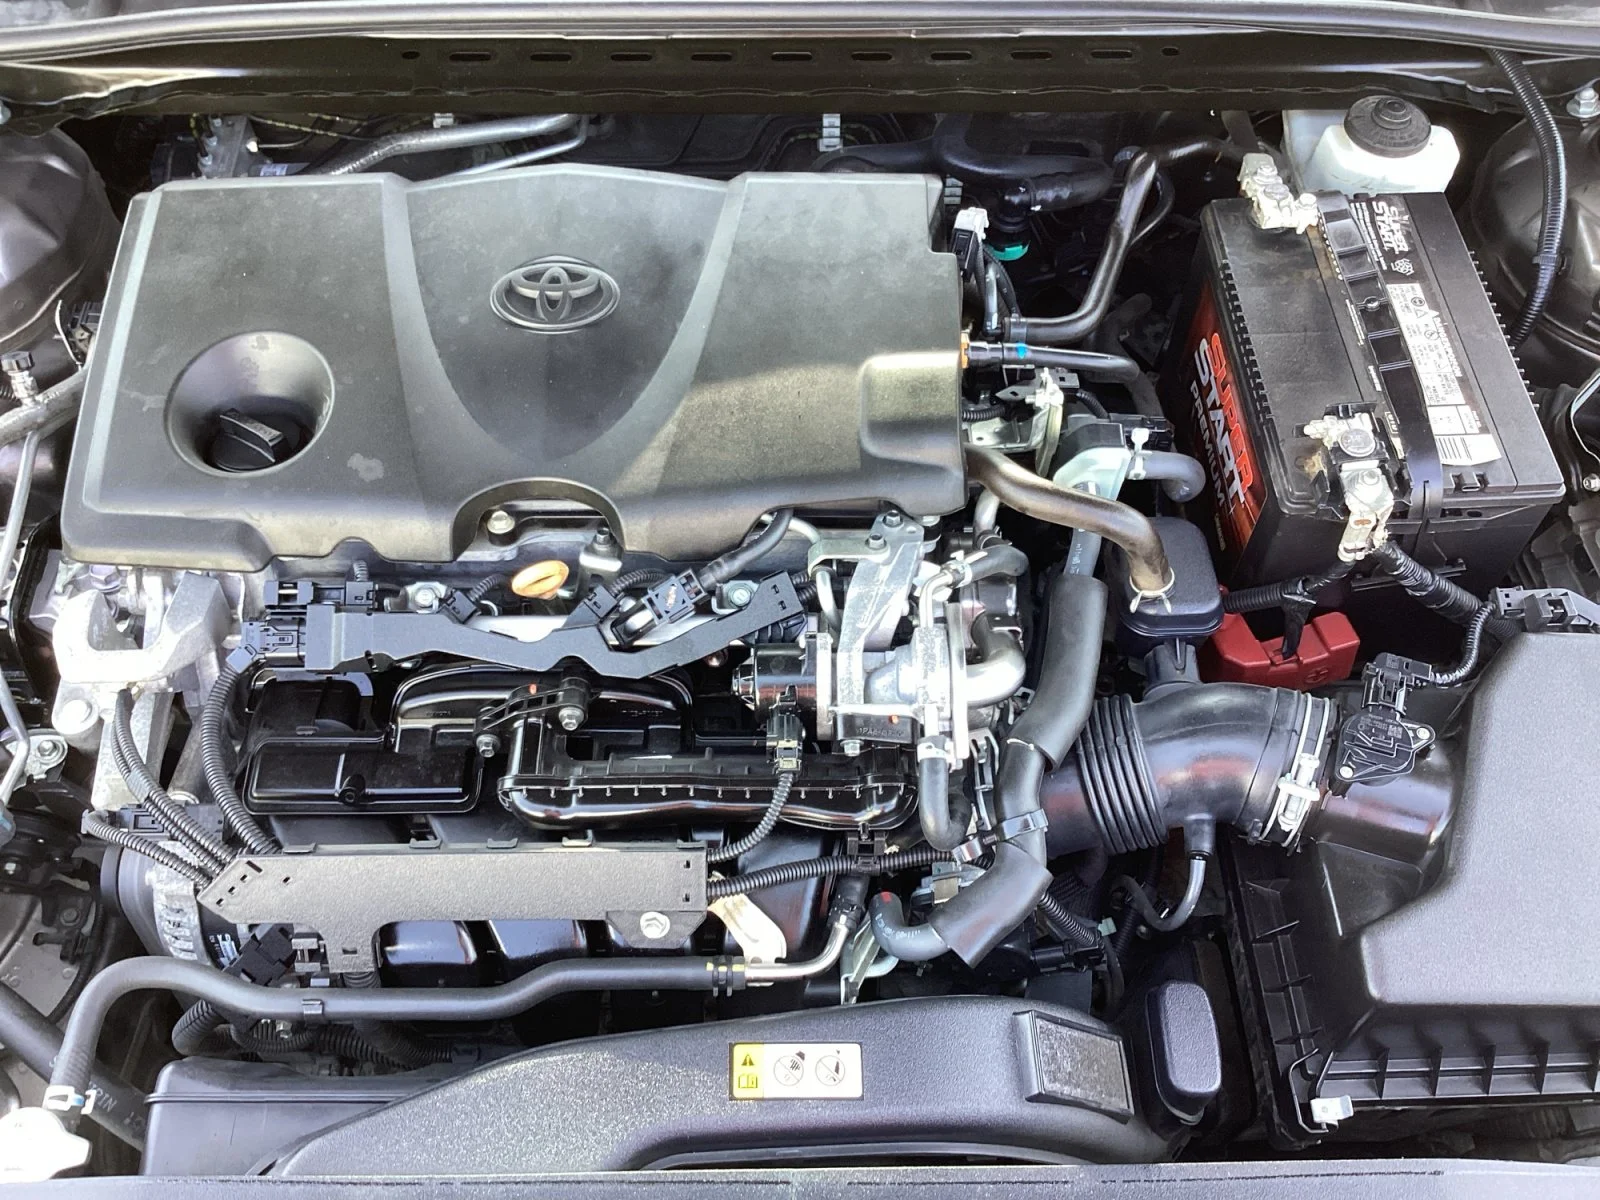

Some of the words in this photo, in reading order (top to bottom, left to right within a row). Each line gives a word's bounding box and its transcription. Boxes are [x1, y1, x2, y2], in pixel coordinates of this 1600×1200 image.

[1372, 201, 1399, 254] START
[1389, 206, 1409, 251] SUPER
[1190, 380, 1226, 507] PREMIUM
[1195, 338, 1245, 504] START
[1207, 333, 1253, 493] SUPER
